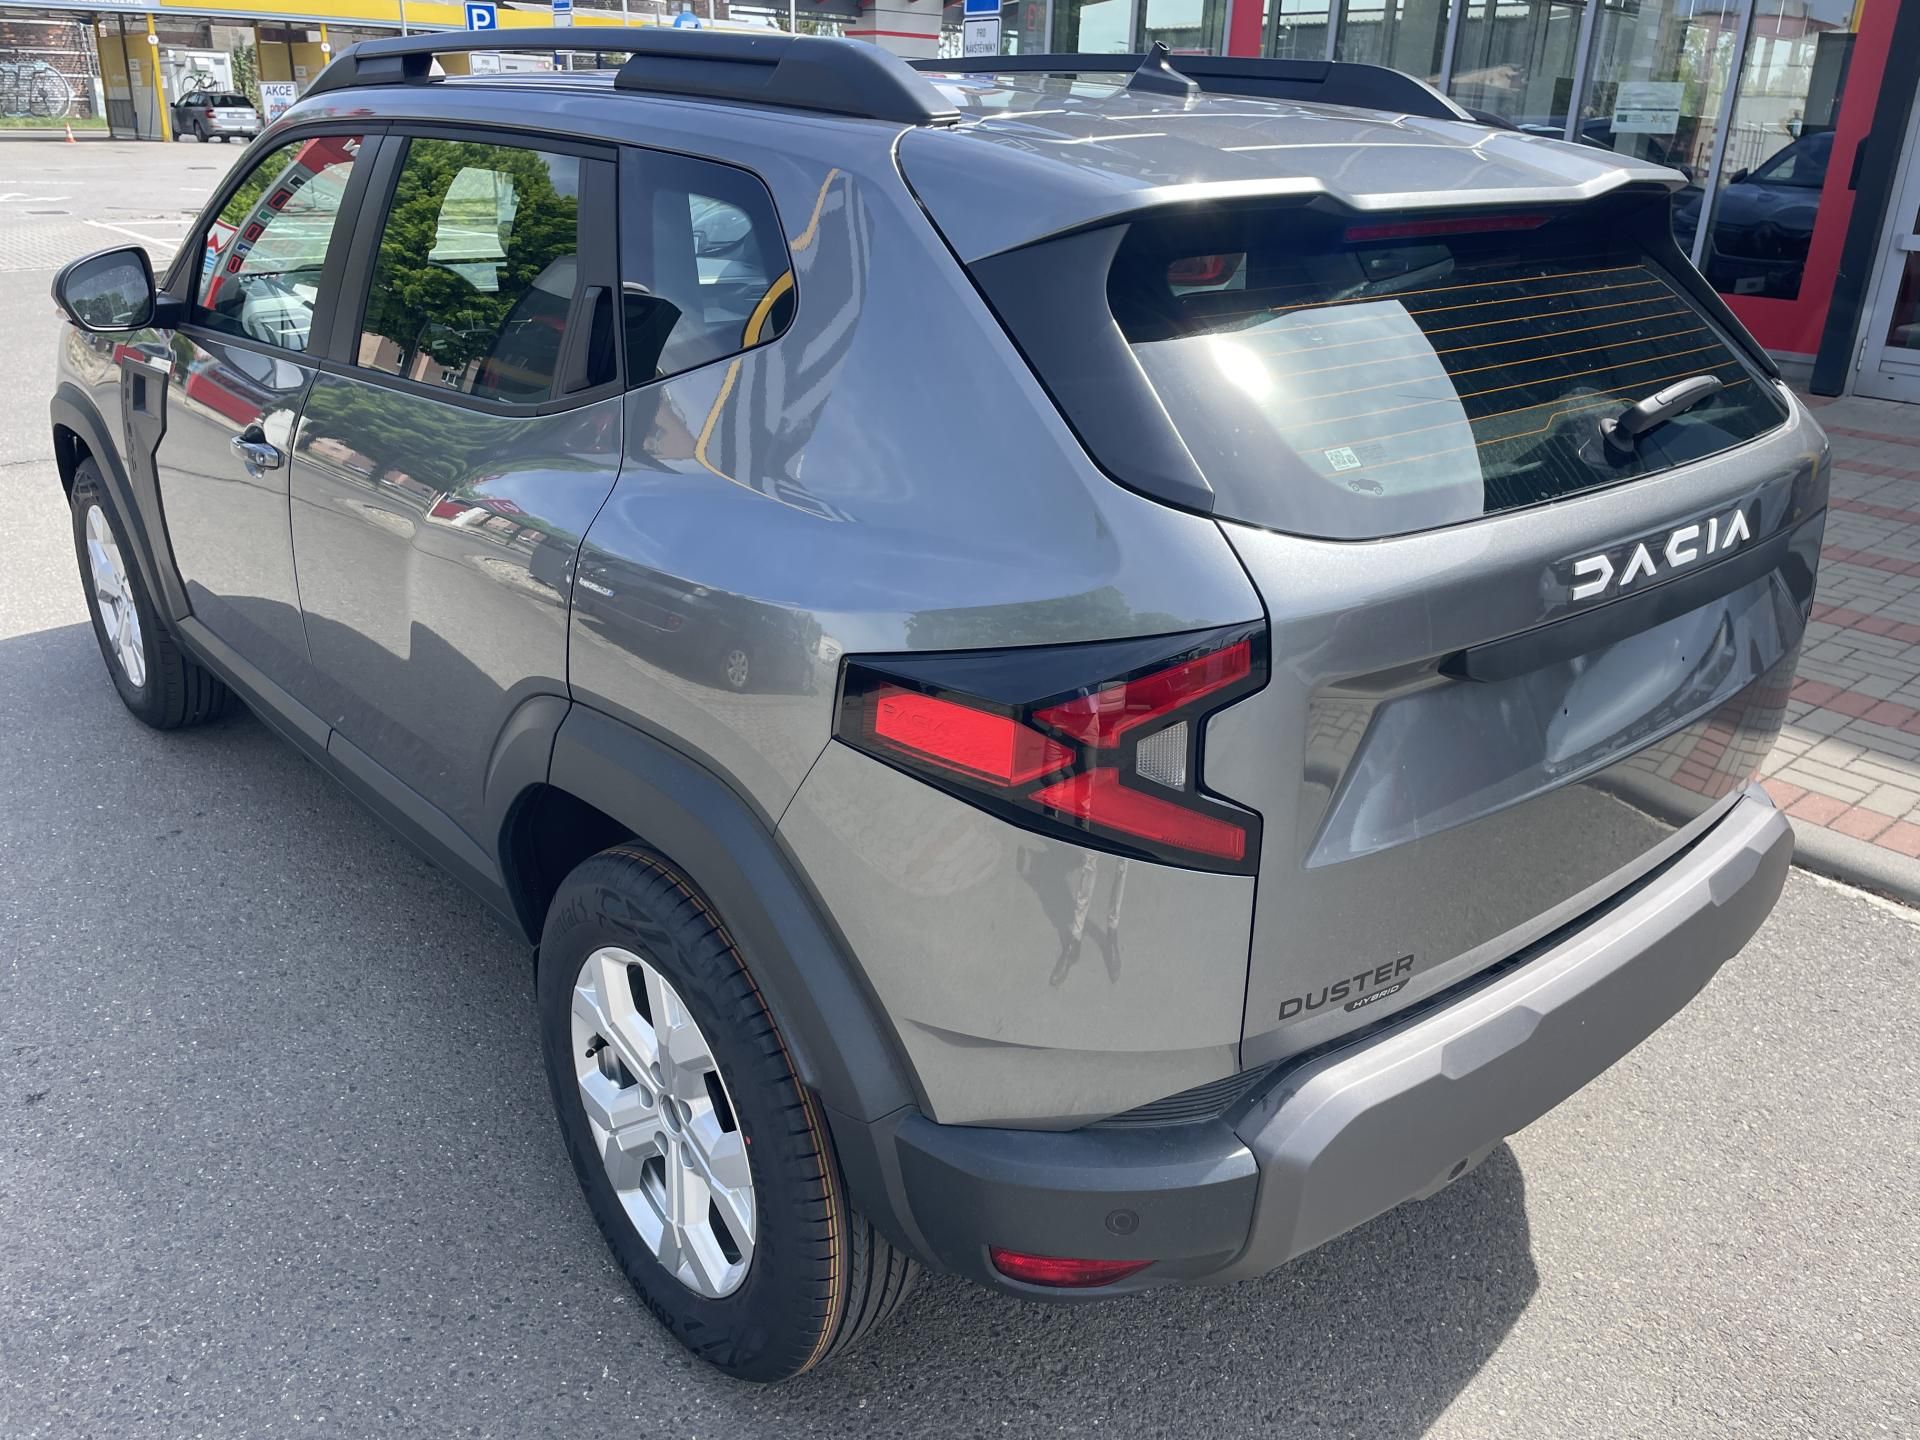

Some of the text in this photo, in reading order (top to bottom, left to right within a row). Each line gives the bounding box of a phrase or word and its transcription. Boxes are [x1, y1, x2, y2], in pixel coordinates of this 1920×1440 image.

[471, 8, 491, 30] P
[265, 85, 292, 96] AKCE
[1571, 509, 1750, 601] DACIA
[1278, 954, 1415, 1021] DUSTER
[1352, 984, 1400, 1009] HYBRID
